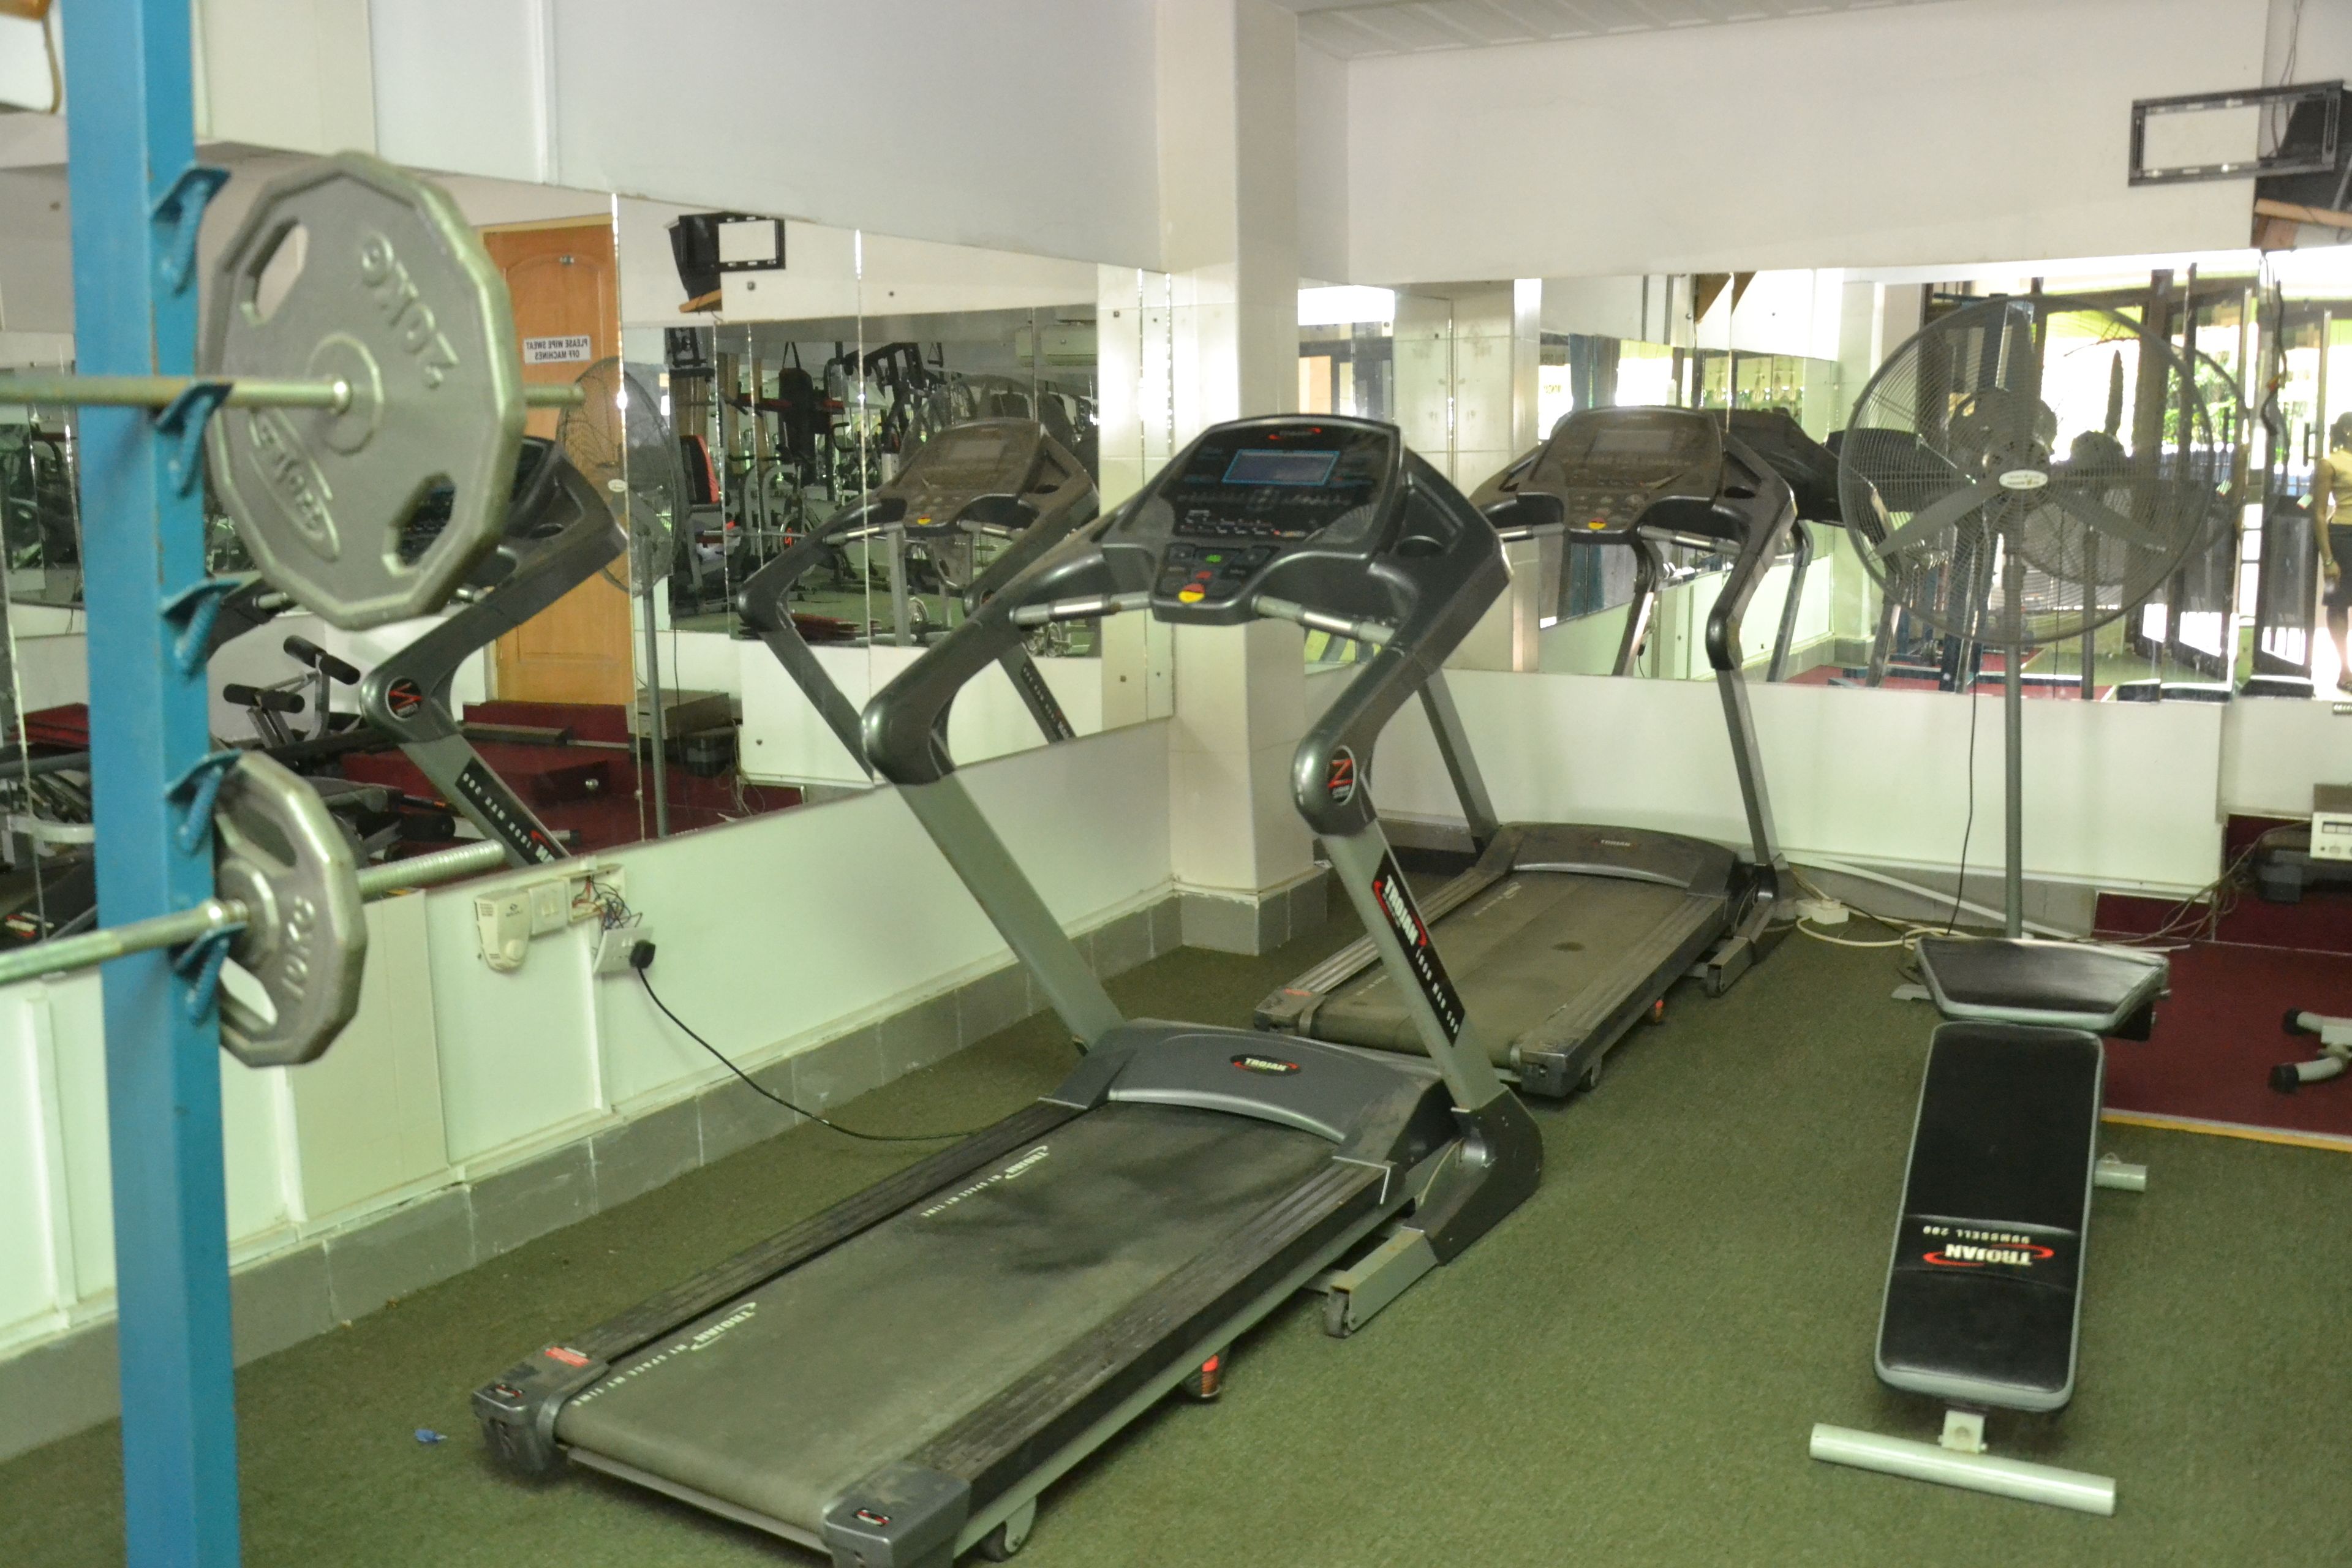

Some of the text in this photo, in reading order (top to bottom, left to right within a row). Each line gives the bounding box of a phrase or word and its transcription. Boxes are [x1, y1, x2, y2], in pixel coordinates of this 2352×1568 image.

[1384, 873, 1419, 946] TROJAN
[1244, 1057, 1287, 1072] TROJAN
[1003, 1151, 1049, 1174] TROJAN
[1922, 1225, 1950, 1237] 200
[1944, 1243, 2033, 1266] TROJAN
[693, 1310, 755, 1342] TROJAN
